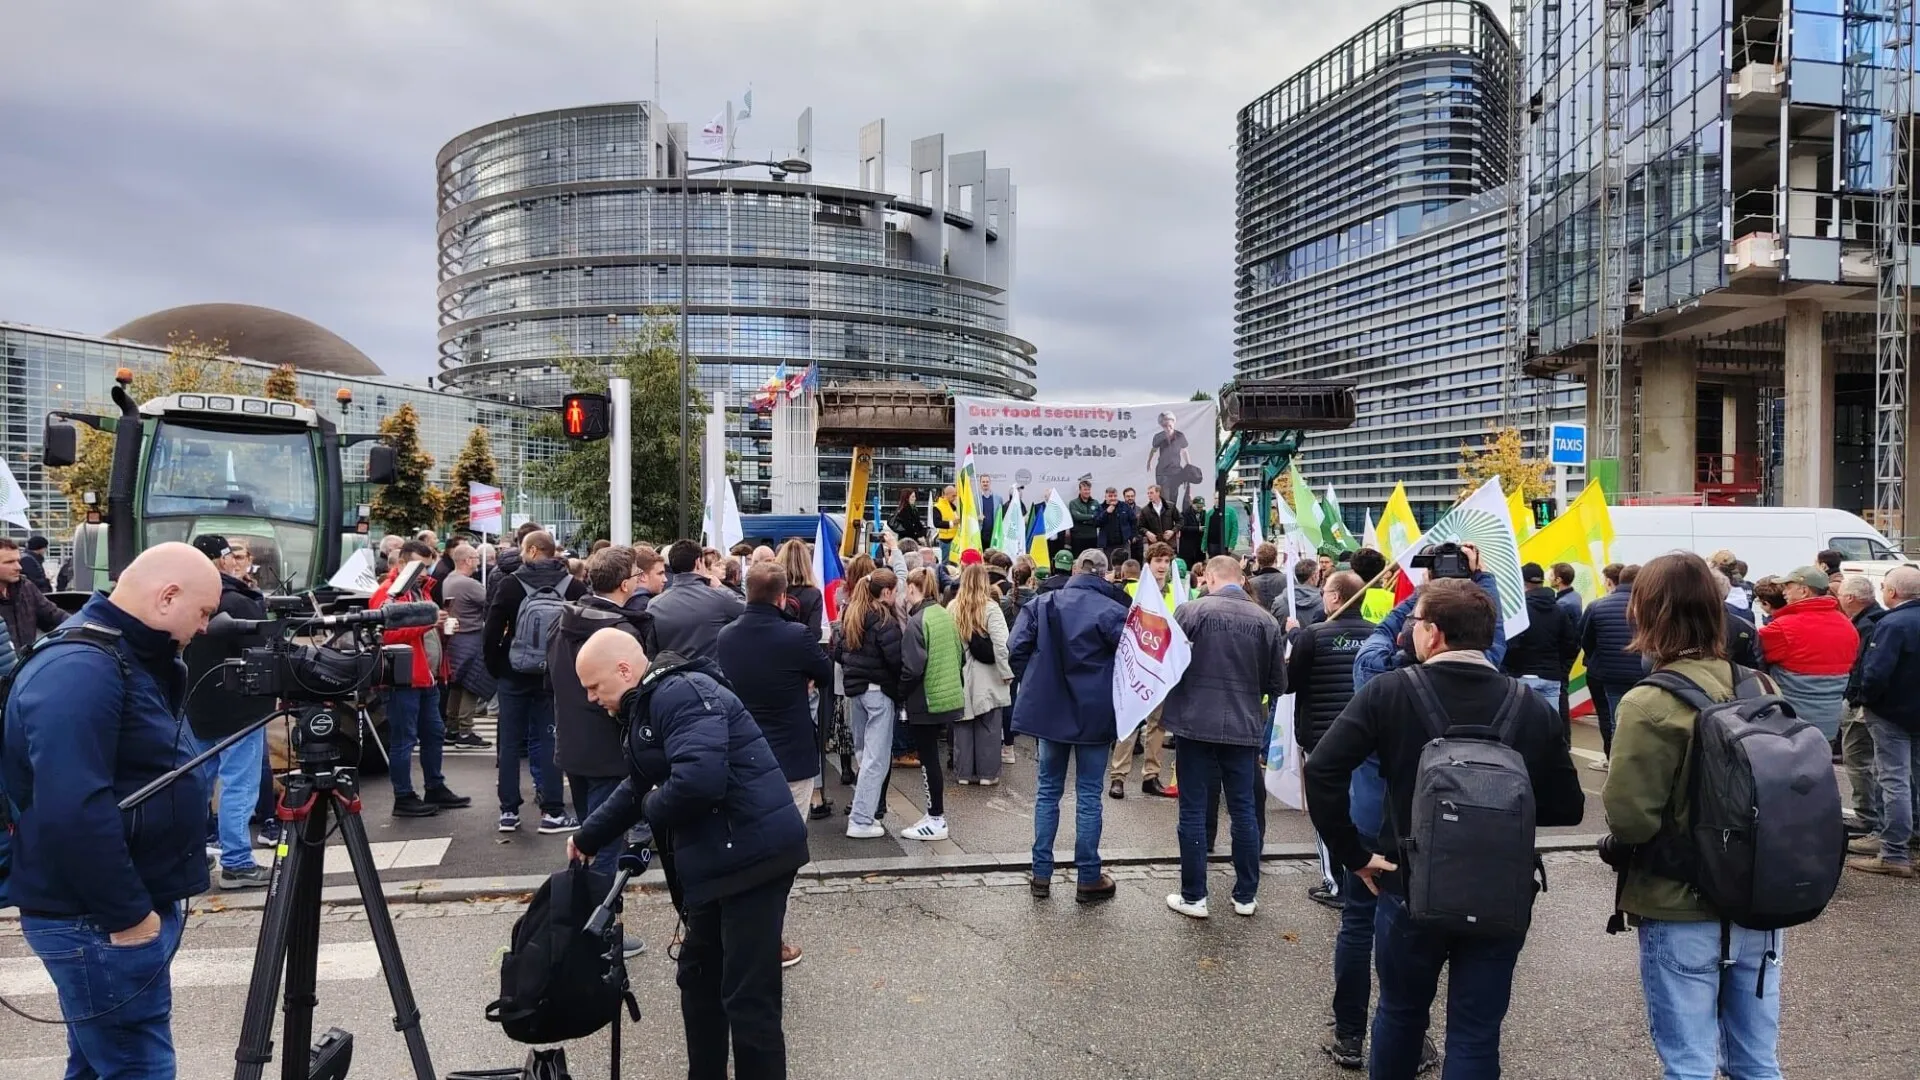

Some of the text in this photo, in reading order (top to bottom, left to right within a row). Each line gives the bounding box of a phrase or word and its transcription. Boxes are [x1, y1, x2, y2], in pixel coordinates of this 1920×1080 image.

[968, 405, 1132, 422] Our food security is
[968, 423, 1137, 442] at risk, don't accept
[971, 442, 999, 455] the
[1554, 438, 1583, 452] TAXIS
[320, 673, 344, 687] SONY
